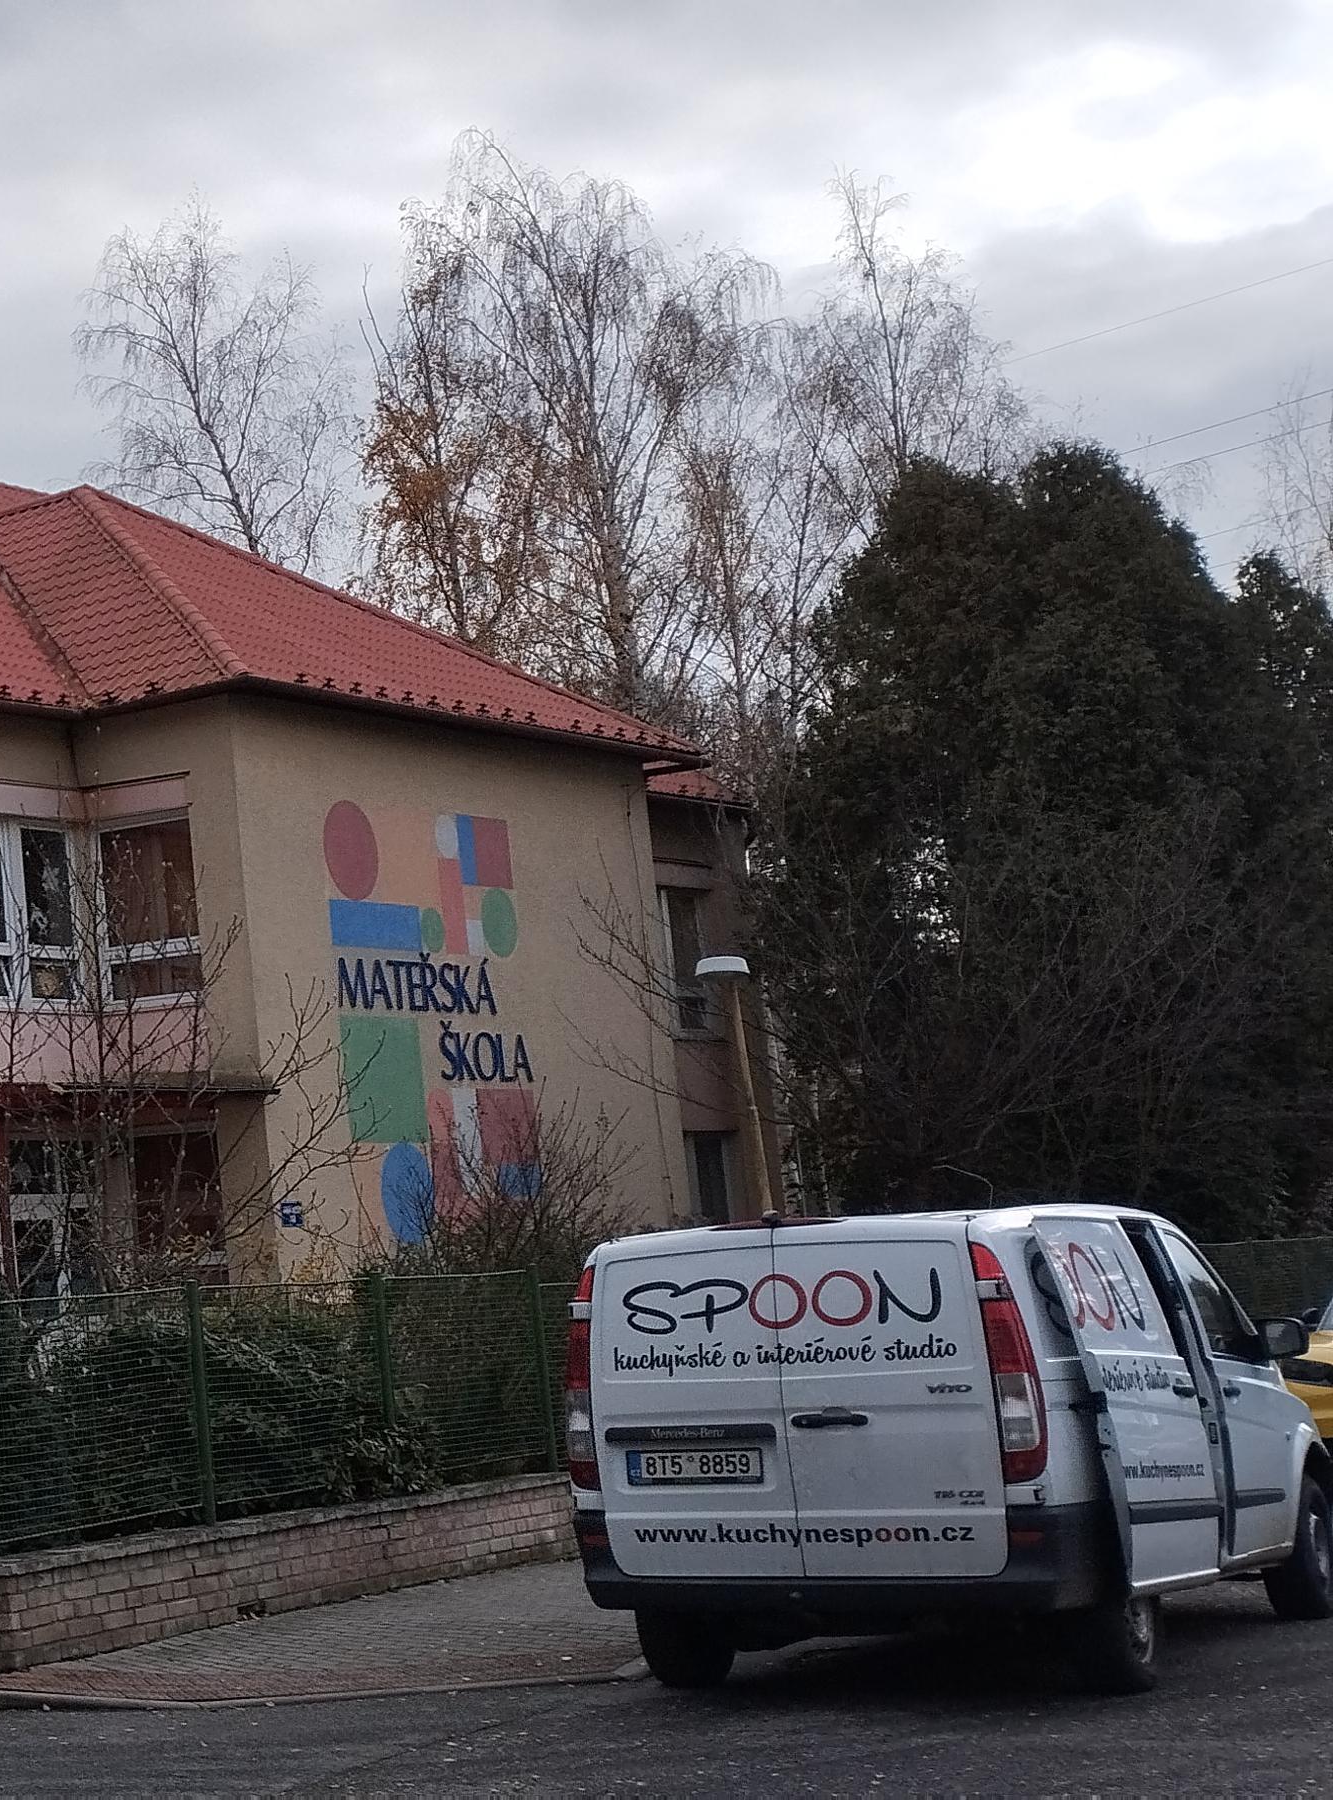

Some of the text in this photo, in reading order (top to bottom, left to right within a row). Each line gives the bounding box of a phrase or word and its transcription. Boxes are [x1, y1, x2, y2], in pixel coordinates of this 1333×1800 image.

[337, 952, 498, 1016] MATEŘSKÁ
[438, 1020, 534, 1083] ŠKOLA
[622, 1267, 942, 1335] SPOON
[614, 1333, 958, 1377] kuchyňské a interiérové studio
[651, 1427, 725, 1440] Mercedes-Benz
[645, 1453, 751, 1476] 8T5 8859
[634, 1522, 975, 1547] www.kuchynespoon.cz
